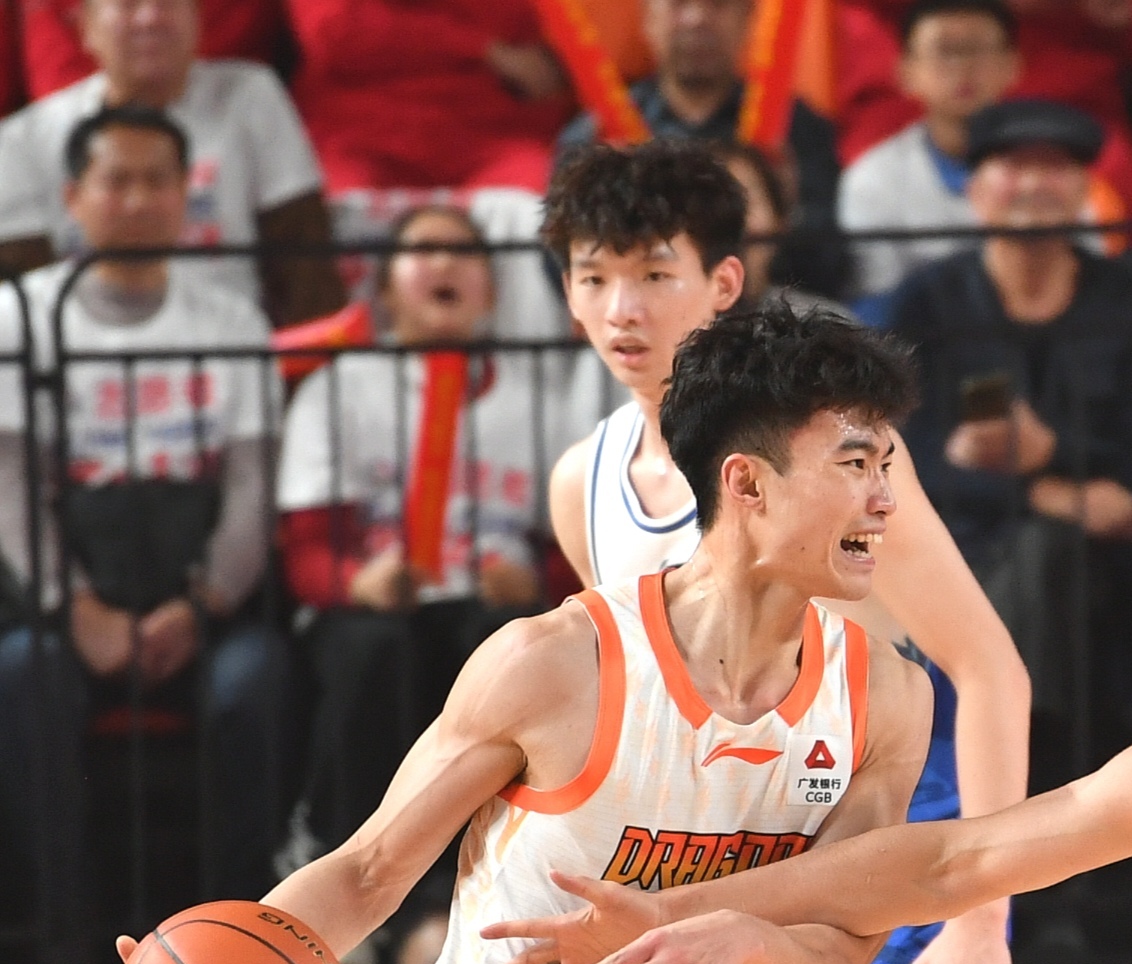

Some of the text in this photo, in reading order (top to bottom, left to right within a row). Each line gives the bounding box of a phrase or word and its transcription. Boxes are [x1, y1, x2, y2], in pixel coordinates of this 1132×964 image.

[797, 778, 841, 790] 广发银行
[805, 791, 832, 803] CGB
